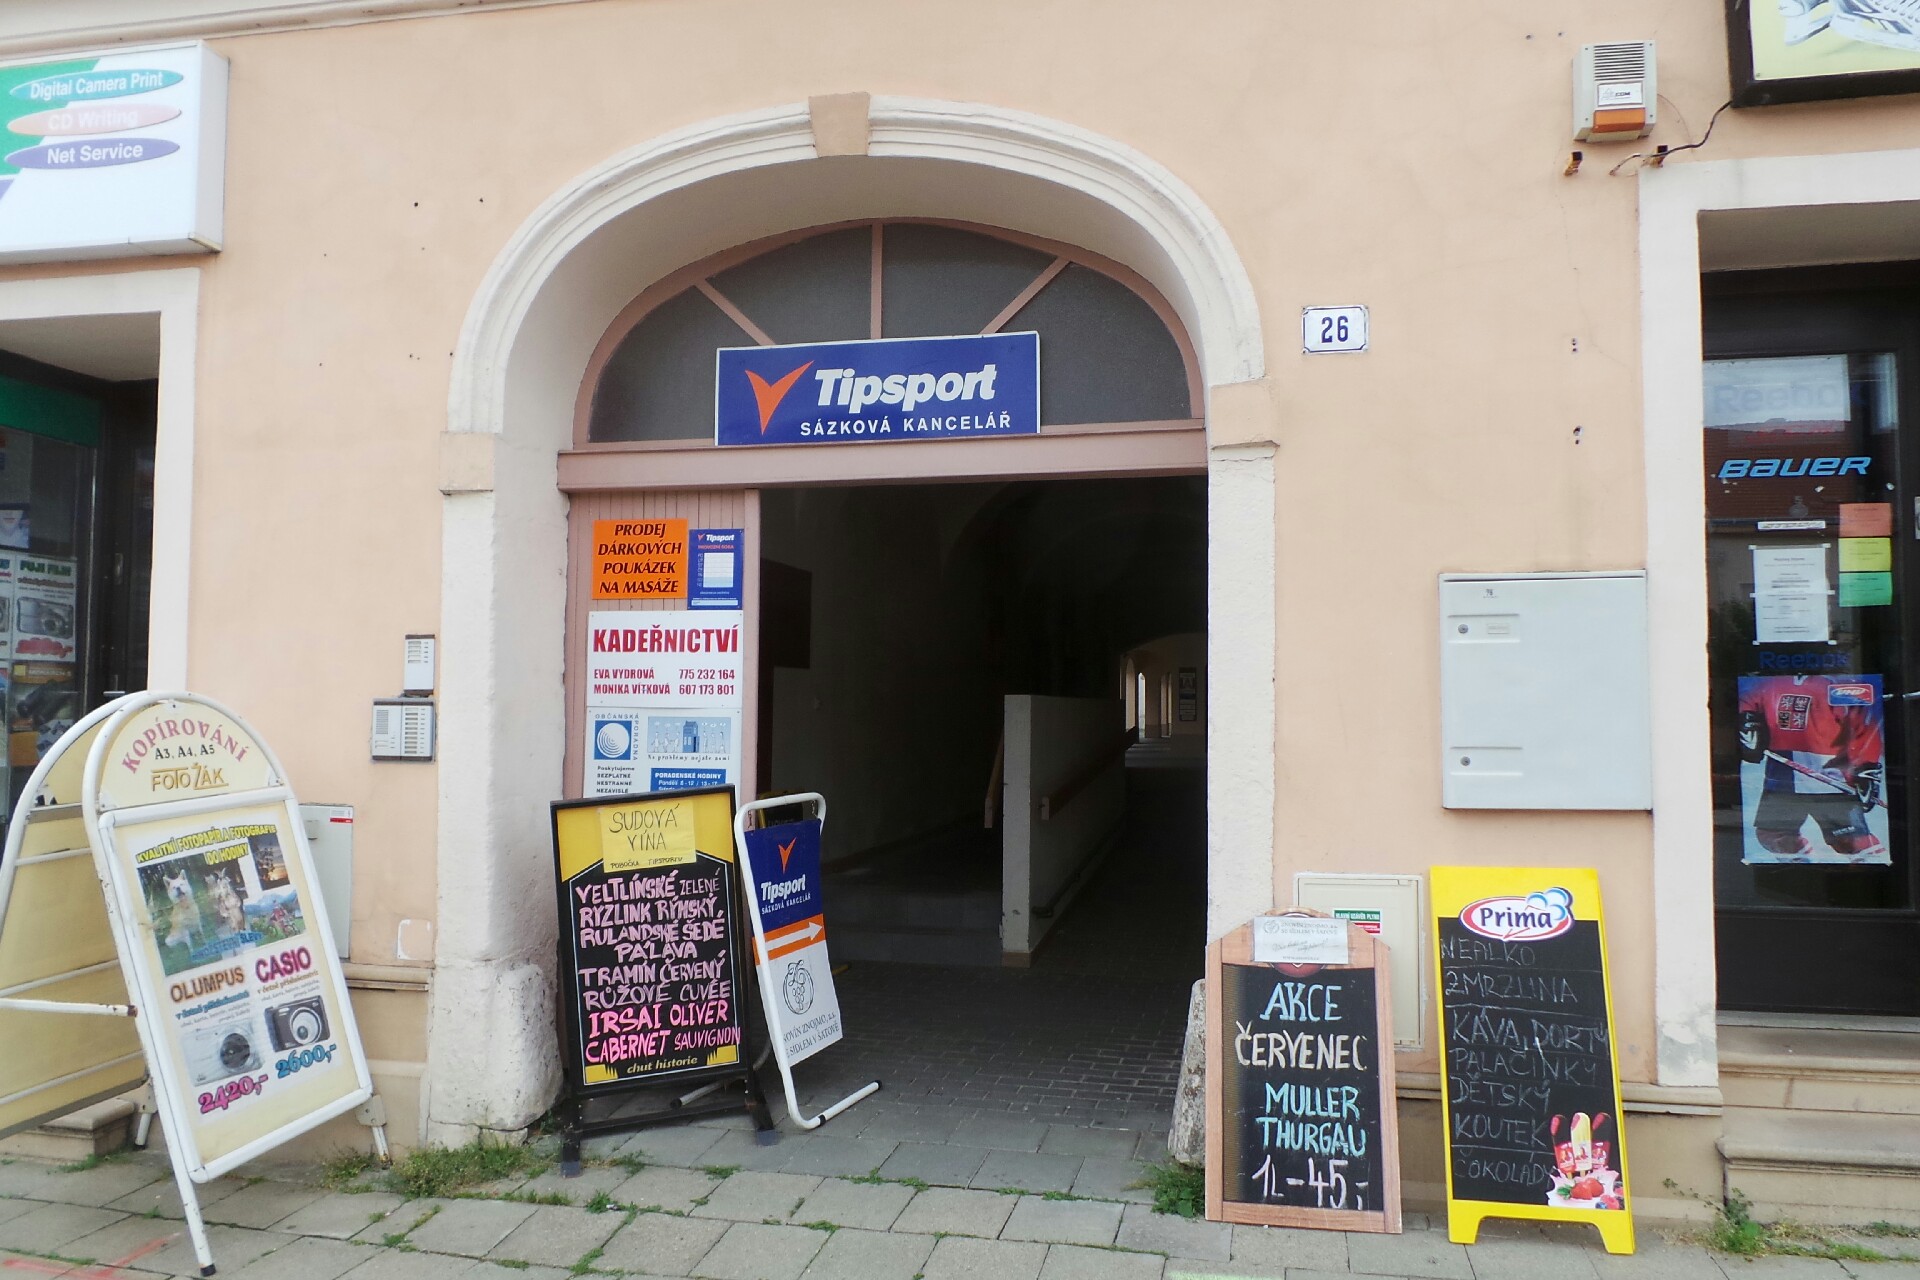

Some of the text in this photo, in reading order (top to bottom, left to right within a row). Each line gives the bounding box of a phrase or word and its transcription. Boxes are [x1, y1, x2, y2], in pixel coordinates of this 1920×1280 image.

[30, 72, 164, 101] Digital Camera Print
[48, 109, 139, 130] CD Writing
[47, 143, 144, 164] Net Service
[1321, 315, 1349, 343] 26
[815, 364, 998, 414] Tipsport
[800, 411, 1011, 436] SÁZKOVÁ KANCELÁŘ
[614, 523, 667, 539] PRODEJ
[706, 534, 735, 543] Tipsport
[598, 540, 683, 556] DÁRKOVÝCH
[602, 559, 677, 575] POUKÁZEK
[600, 578, 679, 594] NA MASÁŽE
[593, 624, 740, 653] KADEŘNICTVÍ
[594, 667, 655, 680] EVA VYDROVÁ
[679, 669, 735, 680] 775 232 164
[594, 682, 671, 695] MONIKA VÍTKOVÁ
[679, 684, 735, 695] 607 173 801
[122, 717, 250, 774] KOPÍROVÁNÍ
[200, 744, 216, 756] A5
[151, 762, 229, 792] FOTO ŽÁK
[135, 836, 179, 864] KVALITNÍ
[204, 842, 249, 865] DO HODINY
[678, 867, 721, 896] ZELENÉ
[761, 874, 806, 903] Tipsport
[579, 902, 652, 929] RYZLINK
[761, 900, 785, 915] SÁZKOVÁ
[1480, 907, 1553, 928] Prima
[579, 909, 726, 948] RULANDSKÉ ŠEDÉ
[255, 946, 312, 983] CASIO
[614, 941, 698, 963] PÁLAVA
[1440, 936, 1536, 967] NEALKO
[578, 950, 727, 987] TRAMÍN ČERVENÝ
[170, 966, 246, 1004] OLUMPUS
[583, 978, 732, 1011] RŮŽOVÉ CUVÉE
[1259, 982, 1343, 1022] AKCE
[588, 999, 729, 1039] IRSAI OLIVER
[585, 1026, 742, 1064] CABERNET SAUVIGNON
[275, 1044, 338, 1079] 2600,-
[656, 1055, 699, 1070] historie
[1449, 1045, 1597, 1087] PALAČINKY
[198, 1074, 269, 1114] 2420,-
[1450, 1072, 1551, 1112] DĚTSKÝ
[1255, 1117, 1367, 1157] THURGAU
[1454, 1112, 1548, 1149] KOUTEK
